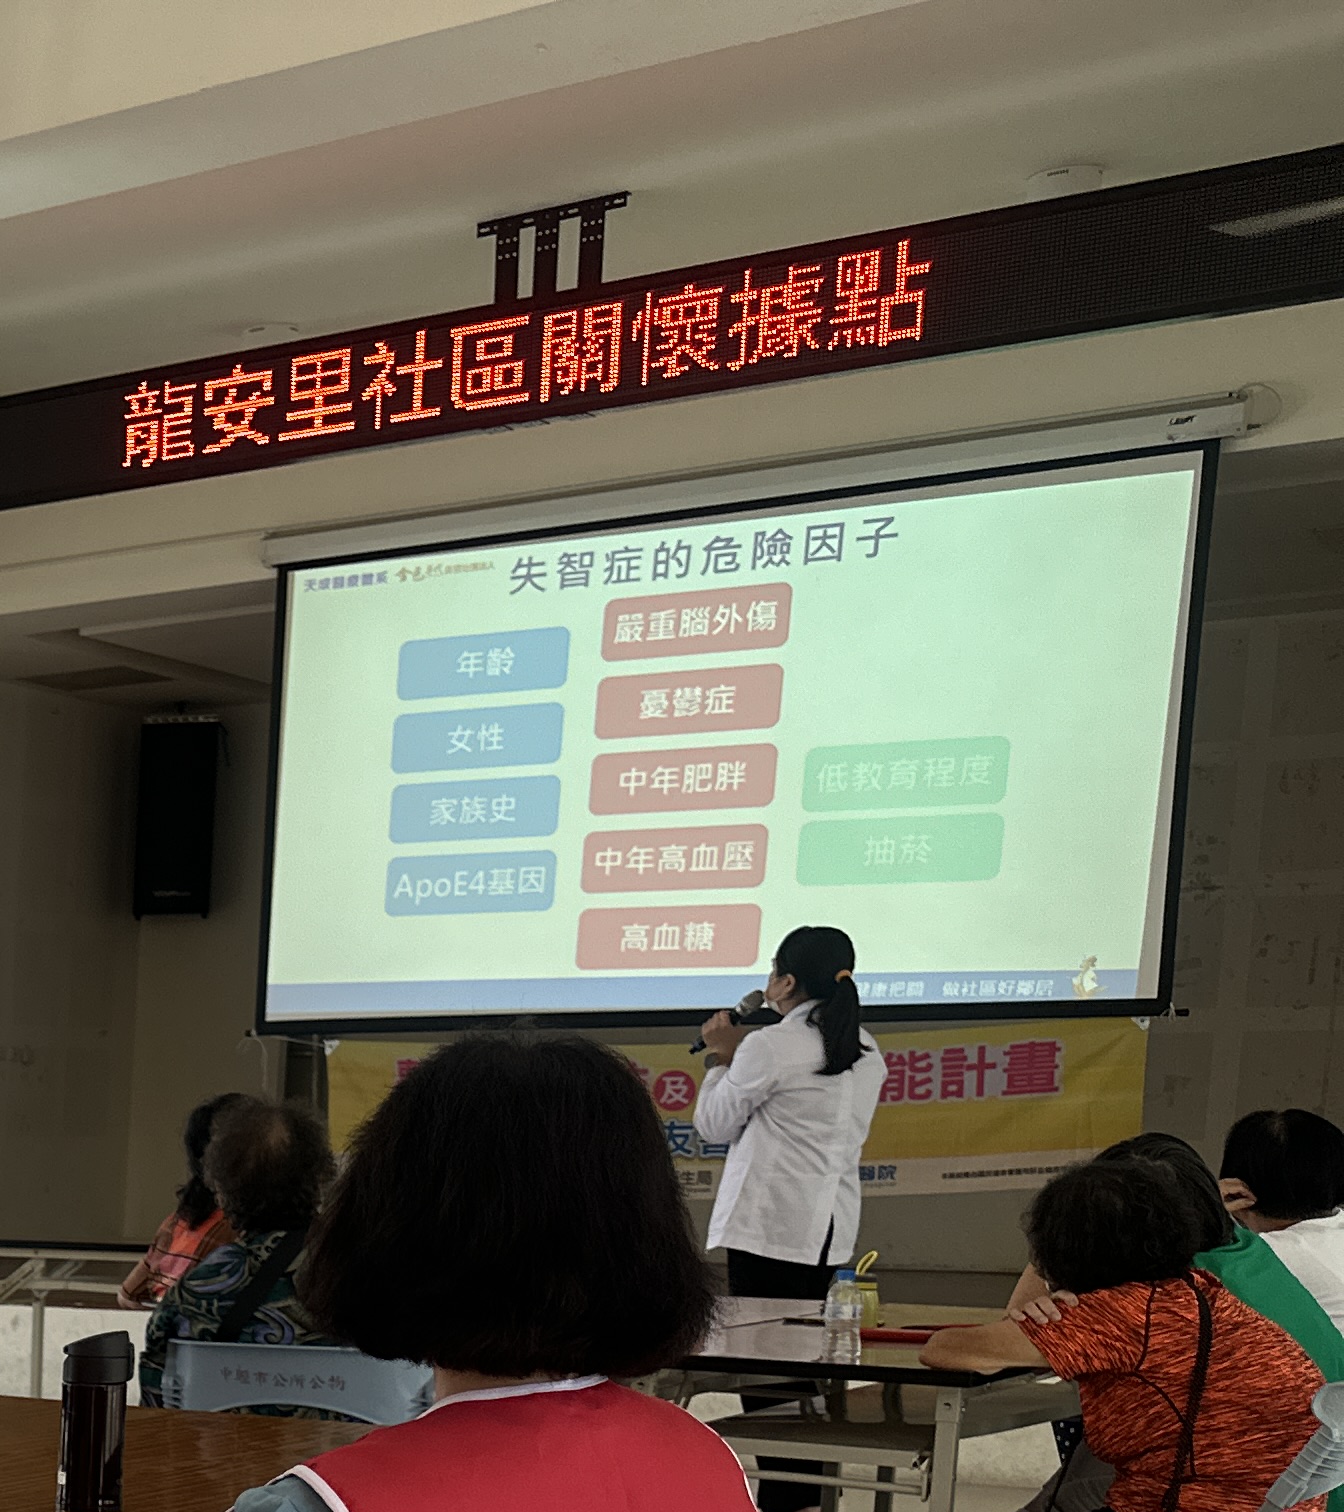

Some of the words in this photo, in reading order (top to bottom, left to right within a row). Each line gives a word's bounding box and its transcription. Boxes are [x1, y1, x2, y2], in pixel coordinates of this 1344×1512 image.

[122, 239, 931, 468] 龍安里社區關懷據點
[510, 516, 900, 595] 失智症的危險因子
[613, 600, 778, 645] 嚴重腦外傷
[456, 645, 516, 679] 年齡
[638, 684, 737, 721] 憂鬱症
[446, 722, 505, 755] 女性
[618, 760, 747, 796] 中年肥胖
[815, 754, 995, 793] 低教育程度
[429, 794, 517, 827] 家族史
[594, 840, 755, 876] 中年高血壓
[863, 833, 933, 867] 抽菸
[393, 865, 546, 906] ApoE4基因
[619, 921, 716, 953] 高血糖
[658, 1069, 691, 1105] 及
